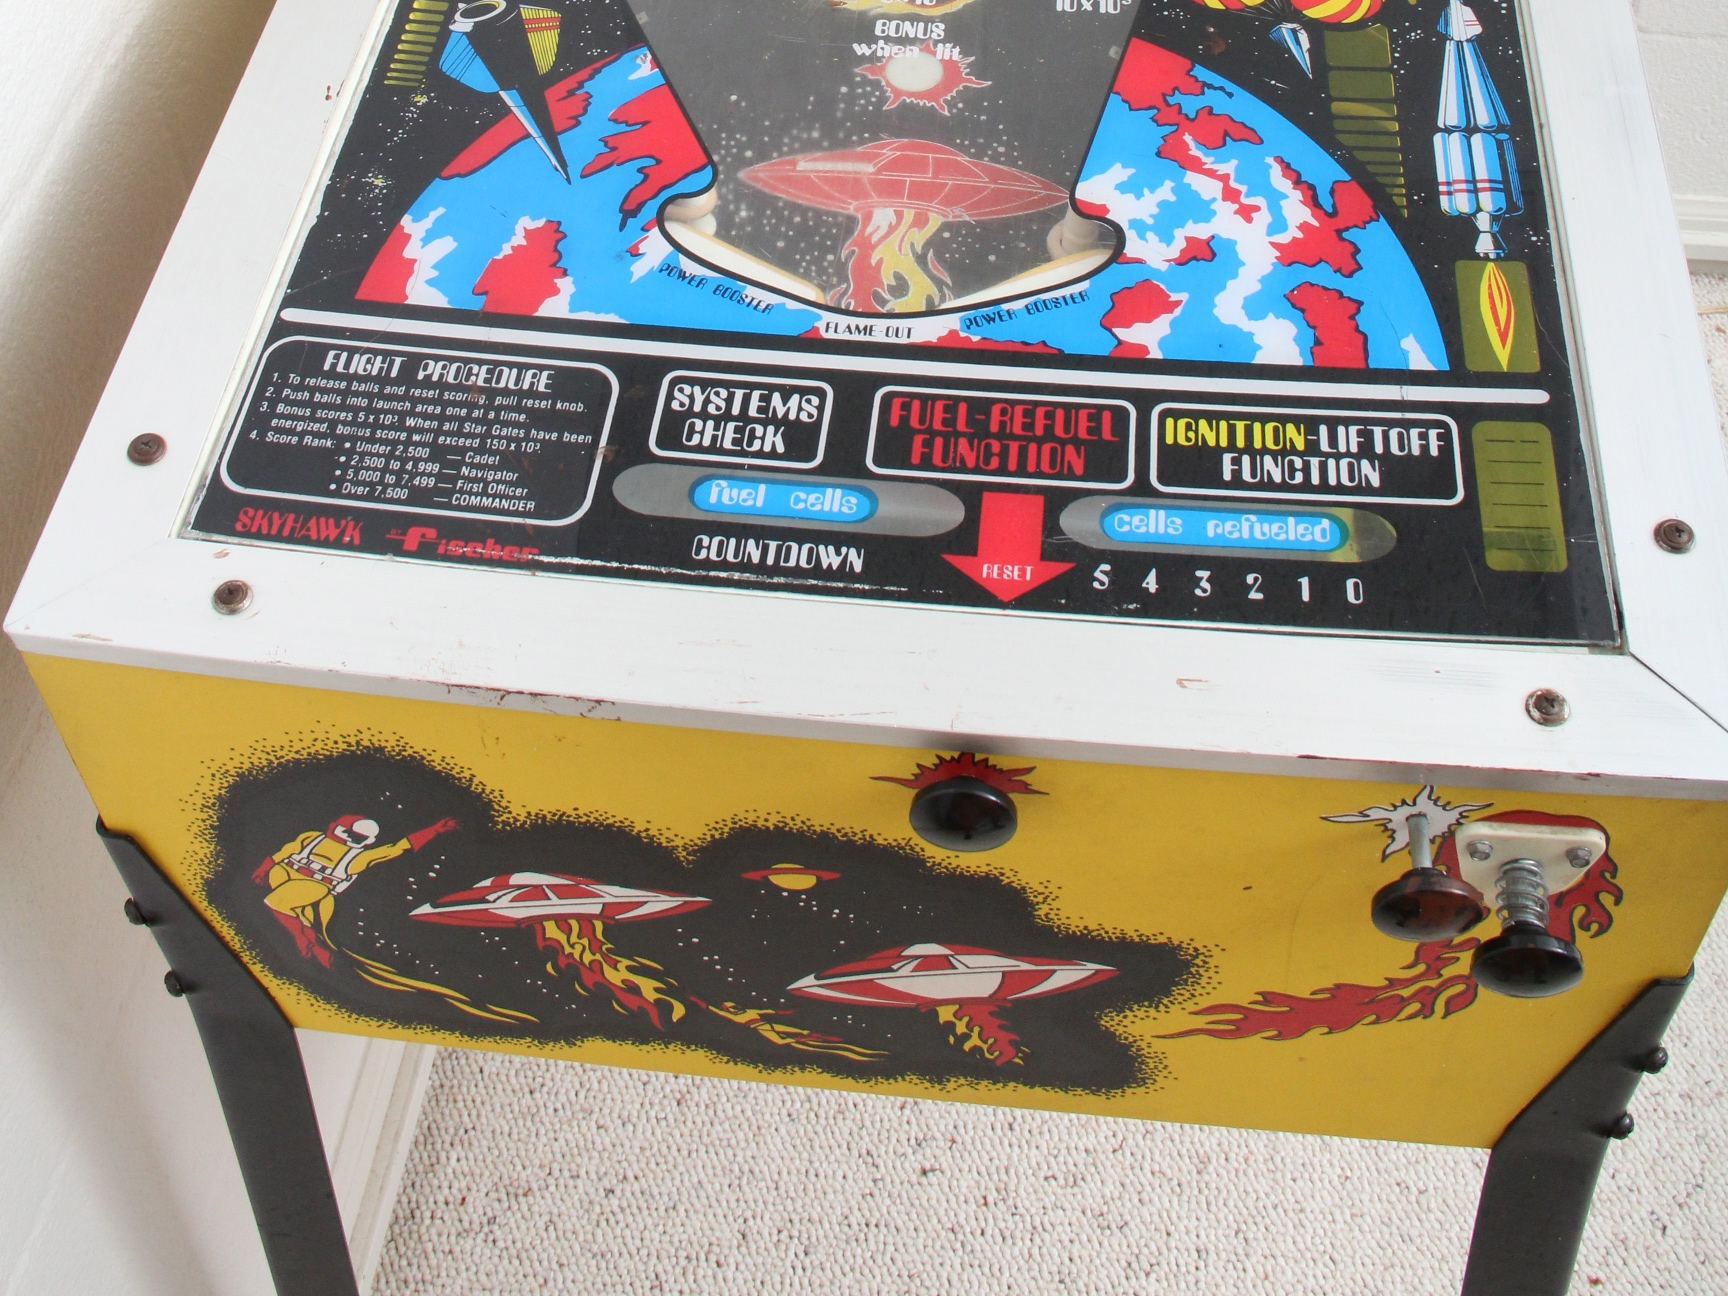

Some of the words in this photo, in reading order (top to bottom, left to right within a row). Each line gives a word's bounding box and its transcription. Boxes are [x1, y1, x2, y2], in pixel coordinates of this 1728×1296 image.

[874, 19, 945, 40] BONUS
[852, 39, 920, 58] when
[935, 42, 961, 61] lit
[659, 262, 708, 290] POWER
[713, 284, 775, 315] BOOSTER
[964, 307, 1018, 331] POWER
[1025, 289, 1091, 316] BOOSTER
[824, 321, 914, 339] FLAME-OUT
[323, 349, 407, 378] FLIGHT
[417, 359, 555, 393] PROCEDURE
[265, 386, 276, 397] 2.
[282, 388, 310, 401] Push
[313, 391, 342, 404] balls
[346, 395, 369, 407] into
[372, 398, 411, 411] launch
[415, 404, 441, 415] area
[446, 407, 468, 417] one
[472, 407, 485, 418] at
[488, 410, 495, 419] a
[500, 410, 530, 423] time.
[272, 372, 281, 383] 1.
[288, 373, 301, 384] To
[305, 376, 347, 389] release
[351, 380, 380, 393] balls
[383, 384, 405, 395] and
[410, 387, 439, 399] reset
[495, 395, 518, 407] pull
[521, 398, 552, 409] reset
[556, 399, 588, 413] knob.
[671, 383, 820, 422] SYSTEMS
[259, 401, 270, 412] 3.
[276, 403, 312, 417] Bonus
[315, 408, 353, 421] scores
[357, 412, 366, 422] 5
[405, 416, 439, 430] When
[443, 420, 459, 432] all
[463, 422, 487, 434] Star
[492, 425, 526, 438] Gates
[530, 428, 558, 441] have
[562, 431, 592, 444] been
[271, 418, 330, 434] energized,
[336, 423, 371, 437] bonus
[375, 430, 407, 441] score
[412, 432, 434, 443] will
[438, 434, 480, 447] exceed
[486, 438, 507, 450] 150
[682, 418, 785, 454] CHECK
[889, 397, 1120, 441] FUEL-REFUEL
[1165, 416, 1446, 457] IGNITION-LIFTOFF
[249, 429, 260, 440] 4.
[265, 431, 299, 445] Score
[303, 434, 337, 449] Rank:
[356, 440, 392, 455] Under
[395, 445, 430, 458] 2,500
[465, 452, 501, 465] Cadet
[910, 434, 1085, 477] FUNCTION
[346, 468, 381, 482] 5,000
[384, 472, 396, 484] to
[401, 474, 436, 488] 7,499
[456, 479, 483, 493] First
[487, 483, 529, 497] Officer
[350, 455, 386, 468] 2,500
[389, 459, 401, 470] to
[405, 461, 440, 474] 4,999
[460, 466, 519, 481] Navigator
[1222, 452, 1381, 488] FUNCTION
[341, 482, 370, 496] Over
[374, 486, 409, 499] 7,500
[451, 494, 536, 512] COMMANDER
[709, 480, 766, 509] fuel
[790, 487, 858, 515] cells
[235, 506, 363, 546] SKYHAWK
[1114, 509, 1184, 536] cells
[1207, 514, 1332, 543] refueled
[692, 534, 864, 574] COUNTDOWN
[982, 564, 1036, 582] RESET
[1092, 563, 1112, 590] 5
[1141, 568, 1160, 594] 4
[1194, 570, 1212, 598] 3
[1246, 573, 1265, 600] 2
[1297, 576, 1311, 602] 1
[1346, 578, 1364, 605] 0
